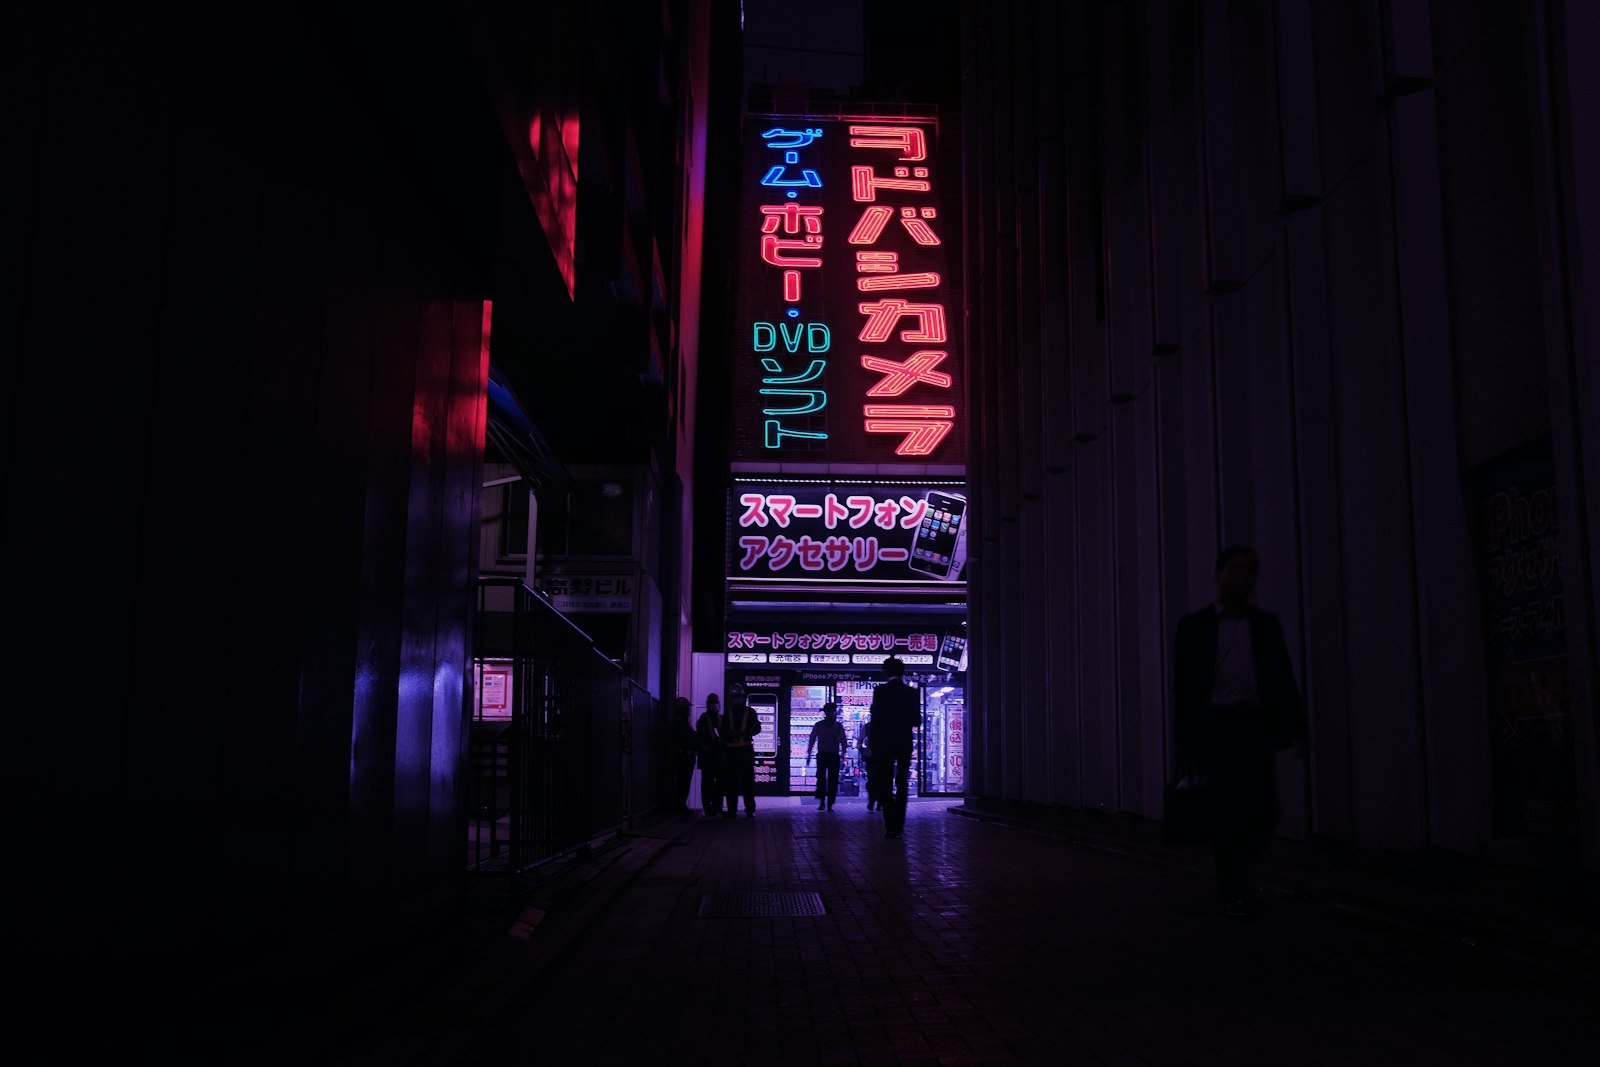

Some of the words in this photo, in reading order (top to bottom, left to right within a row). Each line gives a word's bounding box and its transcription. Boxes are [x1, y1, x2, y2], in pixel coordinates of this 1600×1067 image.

[848, 126, 955, 456] ヨドバシカメラ
[739, 493, 928, 529] スマートフォン
[739, 535, 909, 571] アクセサリー
[545, 578, 631, 596] 高野ビル
[728, 632, 938, 651] スマートフォンアクセサリー売場
[735, 654, 760, 662] ケース
[775, 654, 802, 663] 充電器
[855, 655, 886, 663] モバイルバッテリ
[802, 673, 861, 681] iPhoneアクセサリー
[855, 681, 880, 690] iPho
